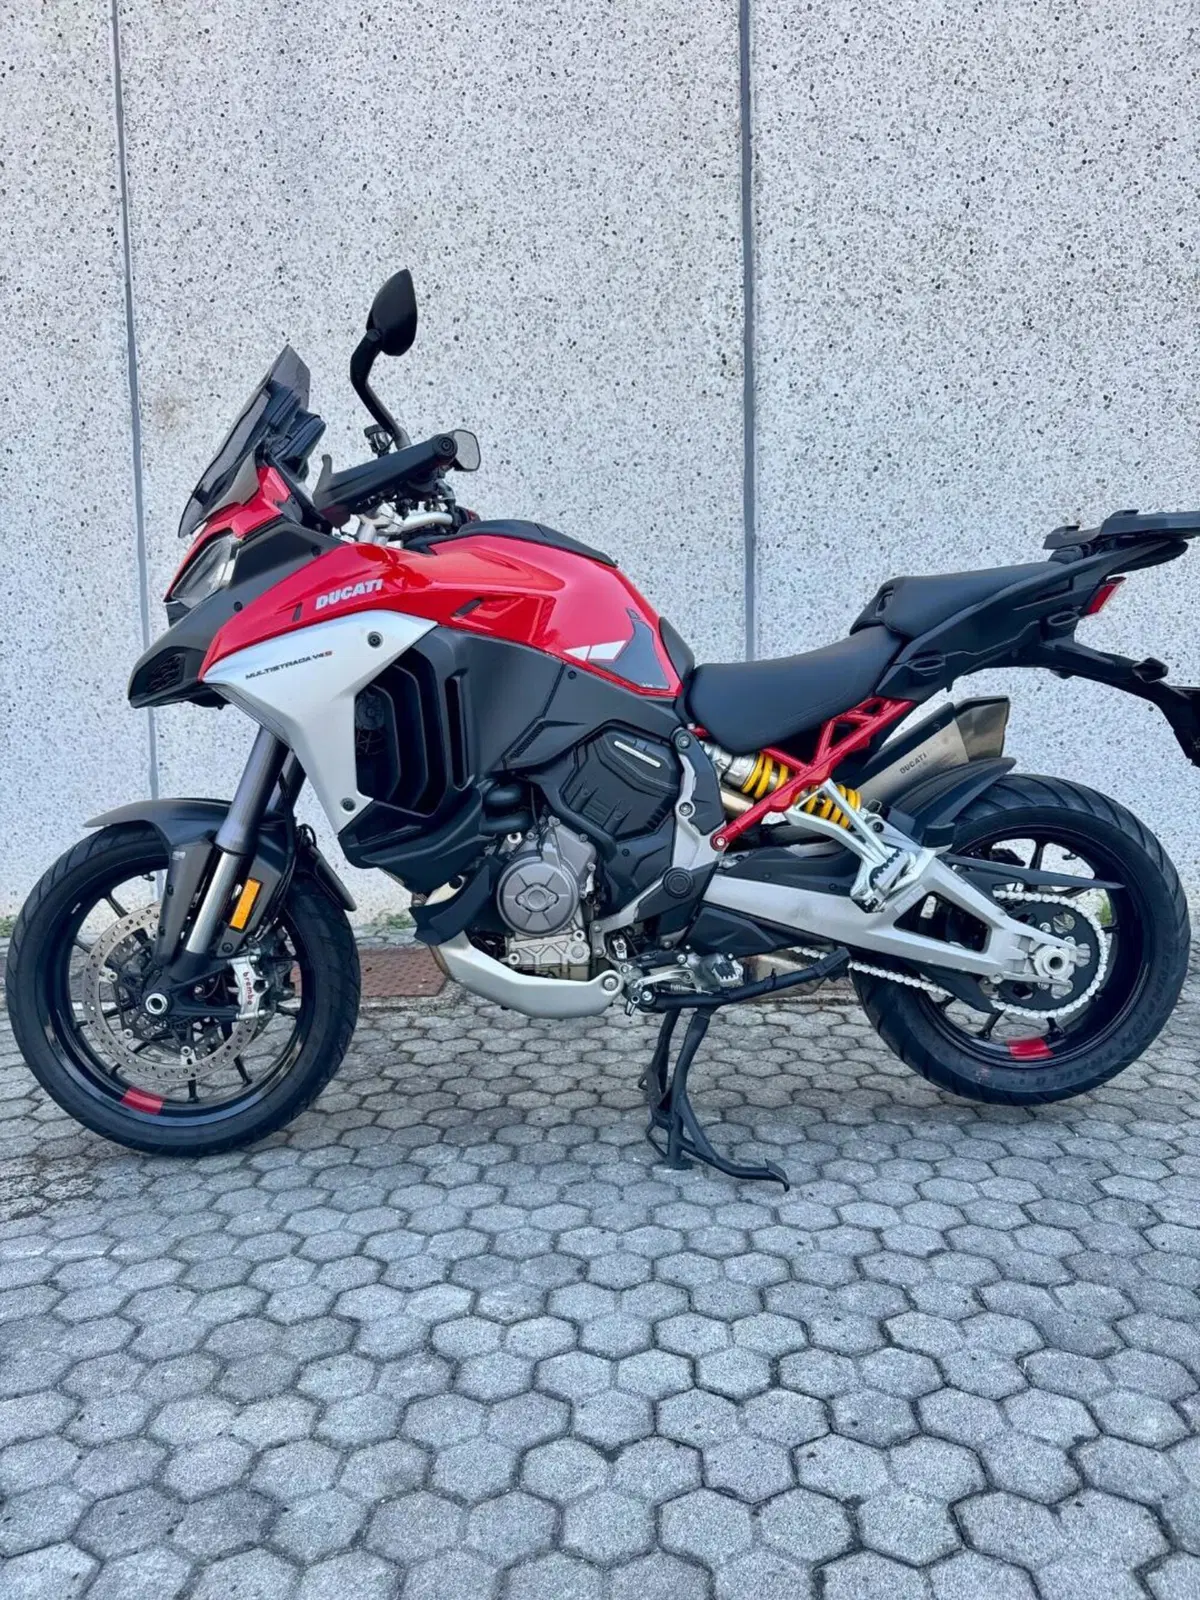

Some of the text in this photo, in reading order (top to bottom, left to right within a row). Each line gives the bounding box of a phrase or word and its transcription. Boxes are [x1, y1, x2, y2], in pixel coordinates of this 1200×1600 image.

[315, 579, 383, 610] DUCATI
[245, 656, 311, 680] MULTISTRADA
[900, 752, 927, 774] DUCATI
[243, 971, 254, 1005] brembo
